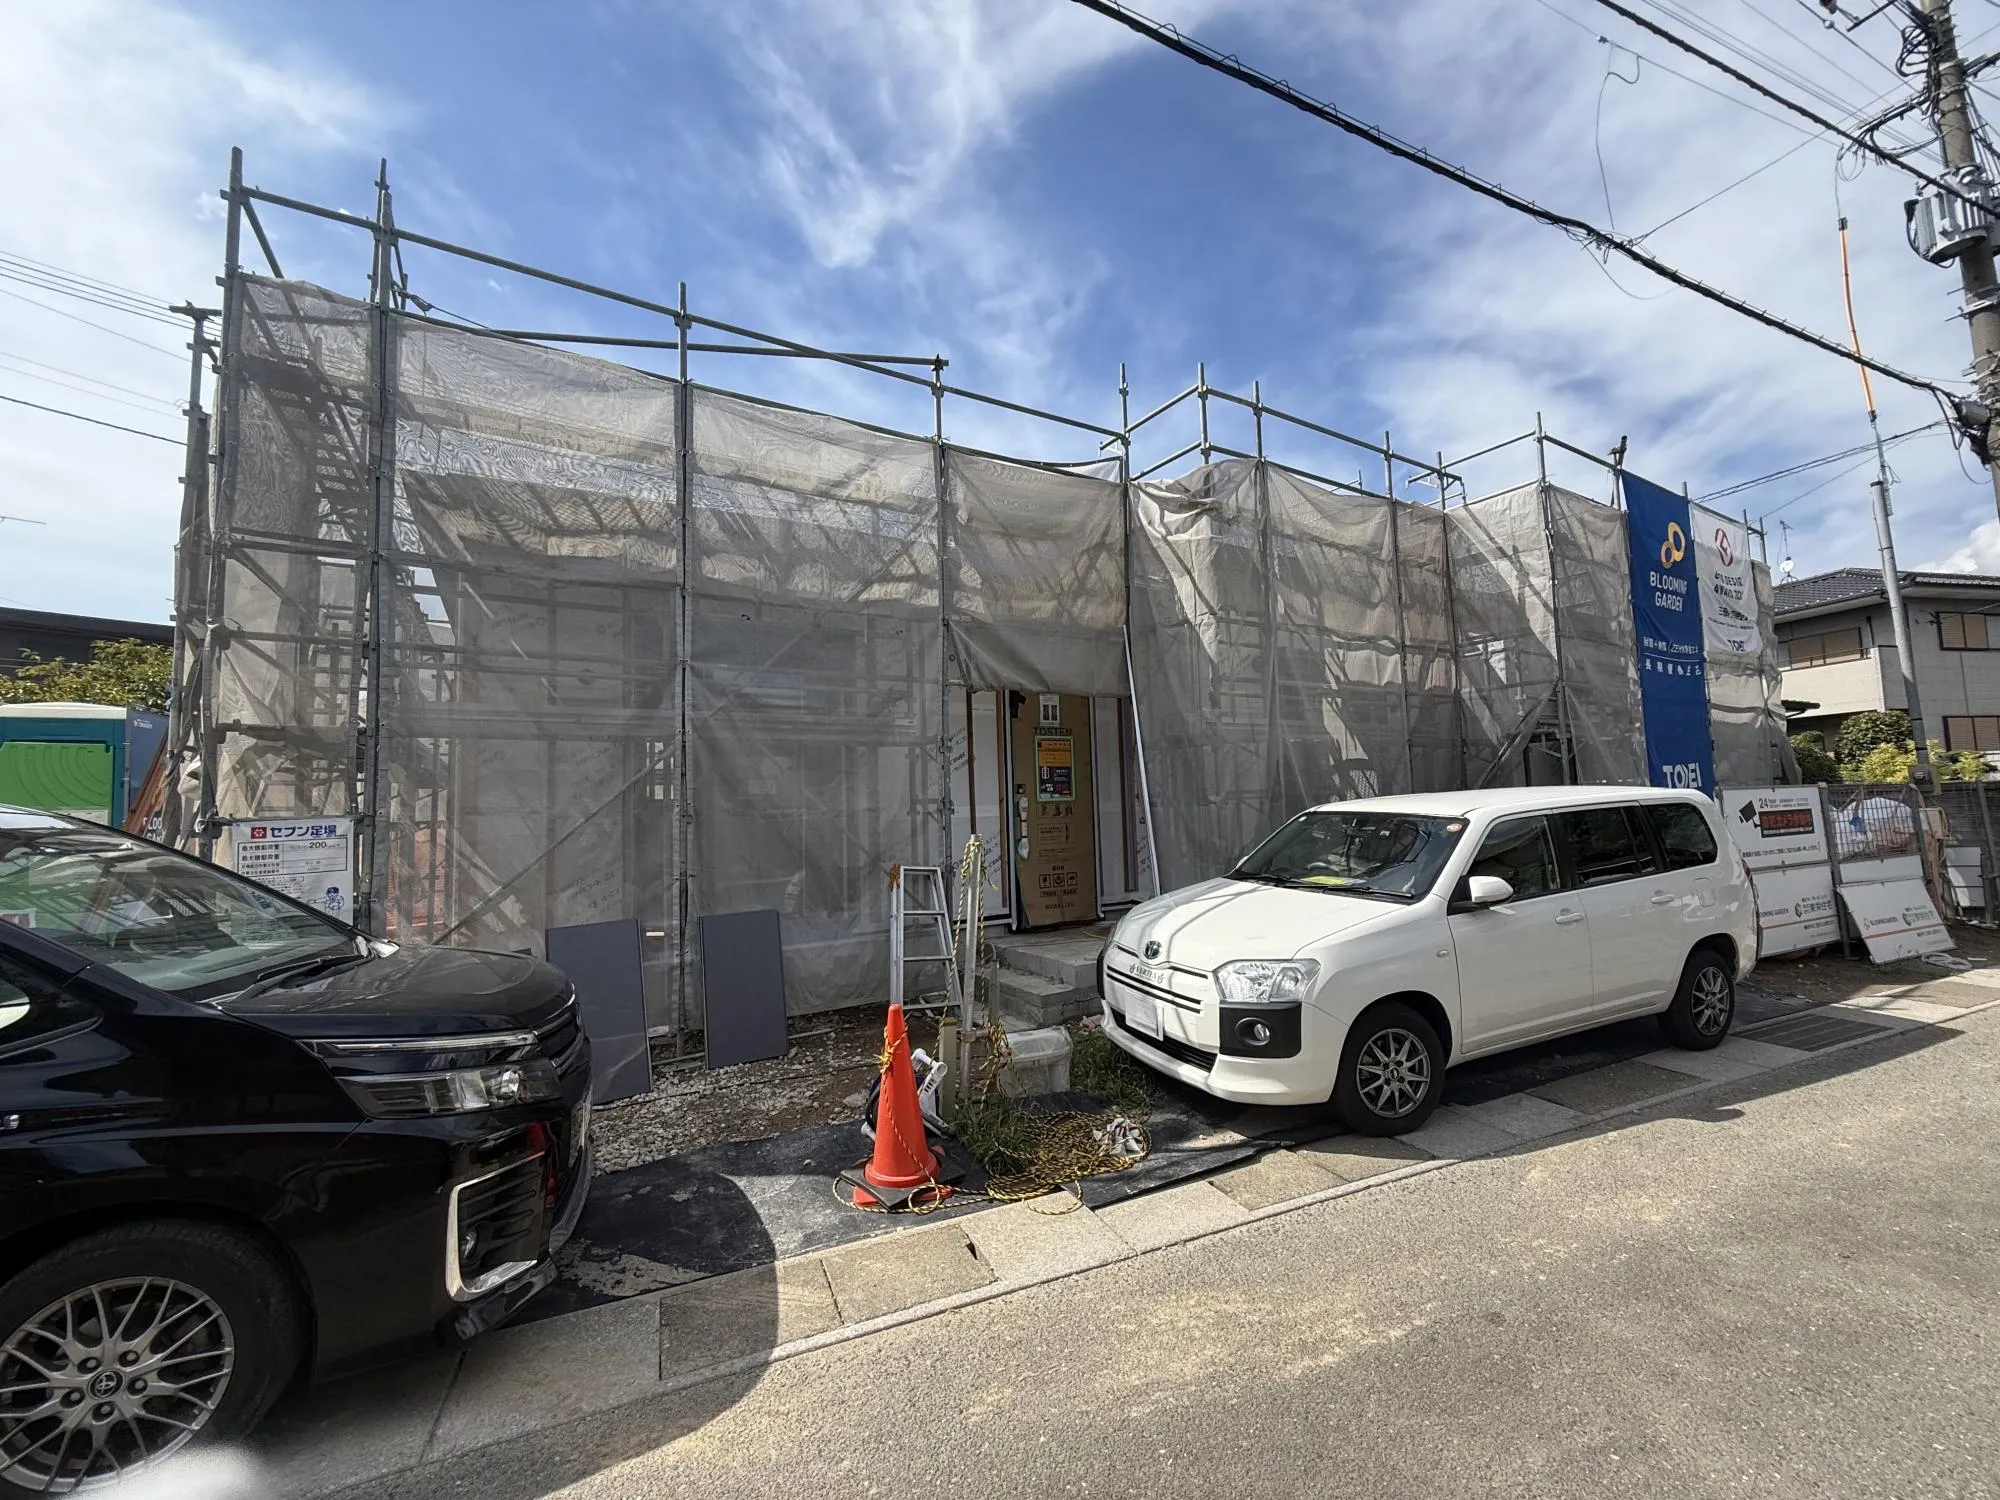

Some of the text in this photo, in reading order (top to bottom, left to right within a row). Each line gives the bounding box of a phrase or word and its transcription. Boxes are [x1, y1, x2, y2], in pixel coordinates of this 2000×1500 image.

[1649, 571, 1687, 595] BLOOMING
[1655, 592, 1683, 612] GARDEN
[1032, 727, 1073, 736] TOSTEM
[1662, 762, 1702, 788] TOEI
[1758, 798, 1769, 809] 24
[270, 824, 337, 838] セブン足場
[309, 841, 327, 849] 200
